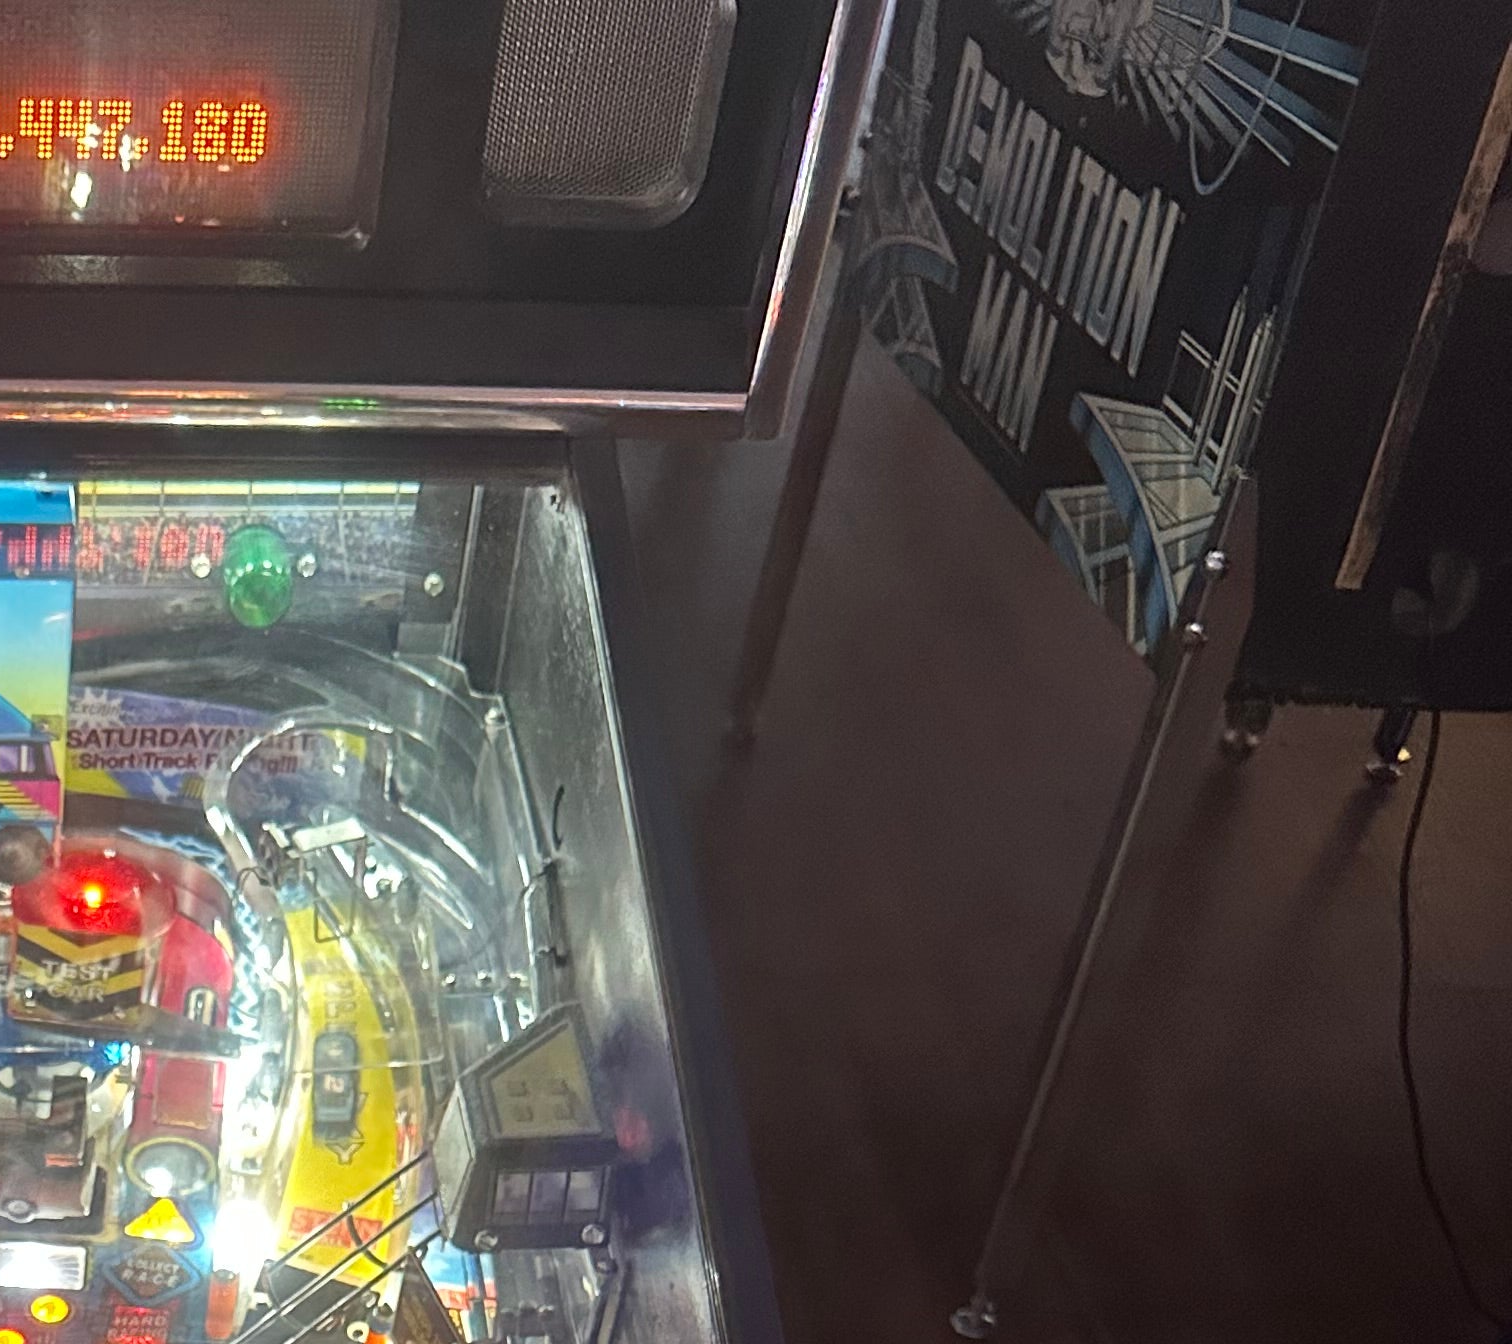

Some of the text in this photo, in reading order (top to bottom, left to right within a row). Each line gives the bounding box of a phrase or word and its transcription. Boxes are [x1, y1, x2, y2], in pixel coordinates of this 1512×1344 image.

[937, 36, 1185, 378] DEMOLITION
[960, 254, 1059, 453] MAN
[66, 728, 216, 749] SATURDAY
[79, 753, 197, 770] Short Track
[42, 961, 113, 979] TEST
[46, 982, 106, 1002] CAR
[126, 1256, 180, 1274] COLLECT
[121, 1269, 180, 1288] RACE
[114, 1315, 168, 1327] HARD
